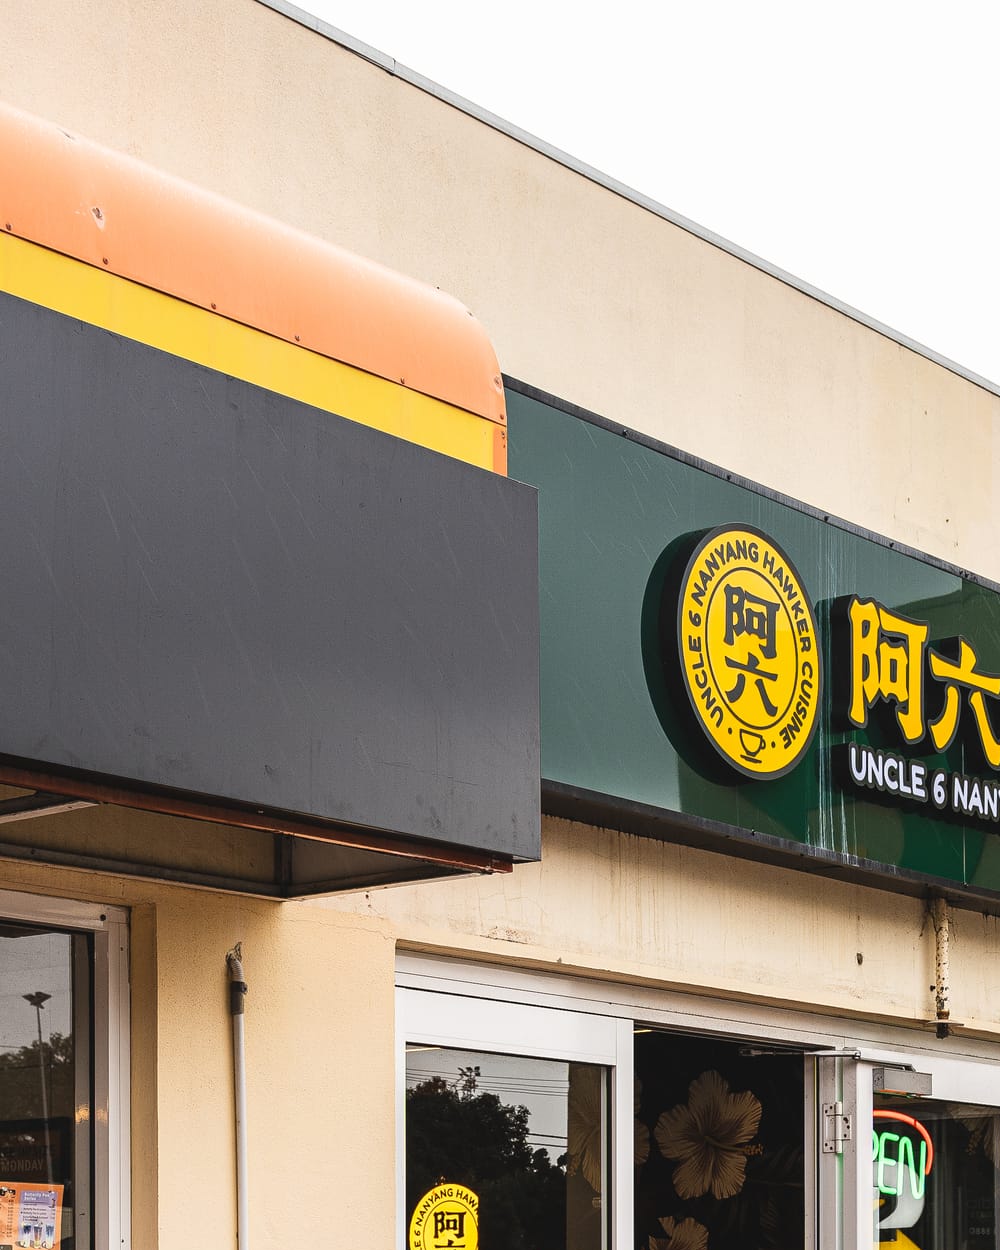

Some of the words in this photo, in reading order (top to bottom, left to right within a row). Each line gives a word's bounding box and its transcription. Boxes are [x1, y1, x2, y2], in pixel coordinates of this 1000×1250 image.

[691, 540, 759, 607] NANYANG
[763, 551, 811, 653] HAWKER
[689, 609, 701, 627] 6
[724, 584, 780, 717] 阿六
[688, 634, 724, 728] UNCLE
[779, 661, 813, 749] CUISINE
[850, 746, 926, 798] UNCLE
[933, 773, 946, 805] 6
[416, 1188, 453, 1227] NANYANG
